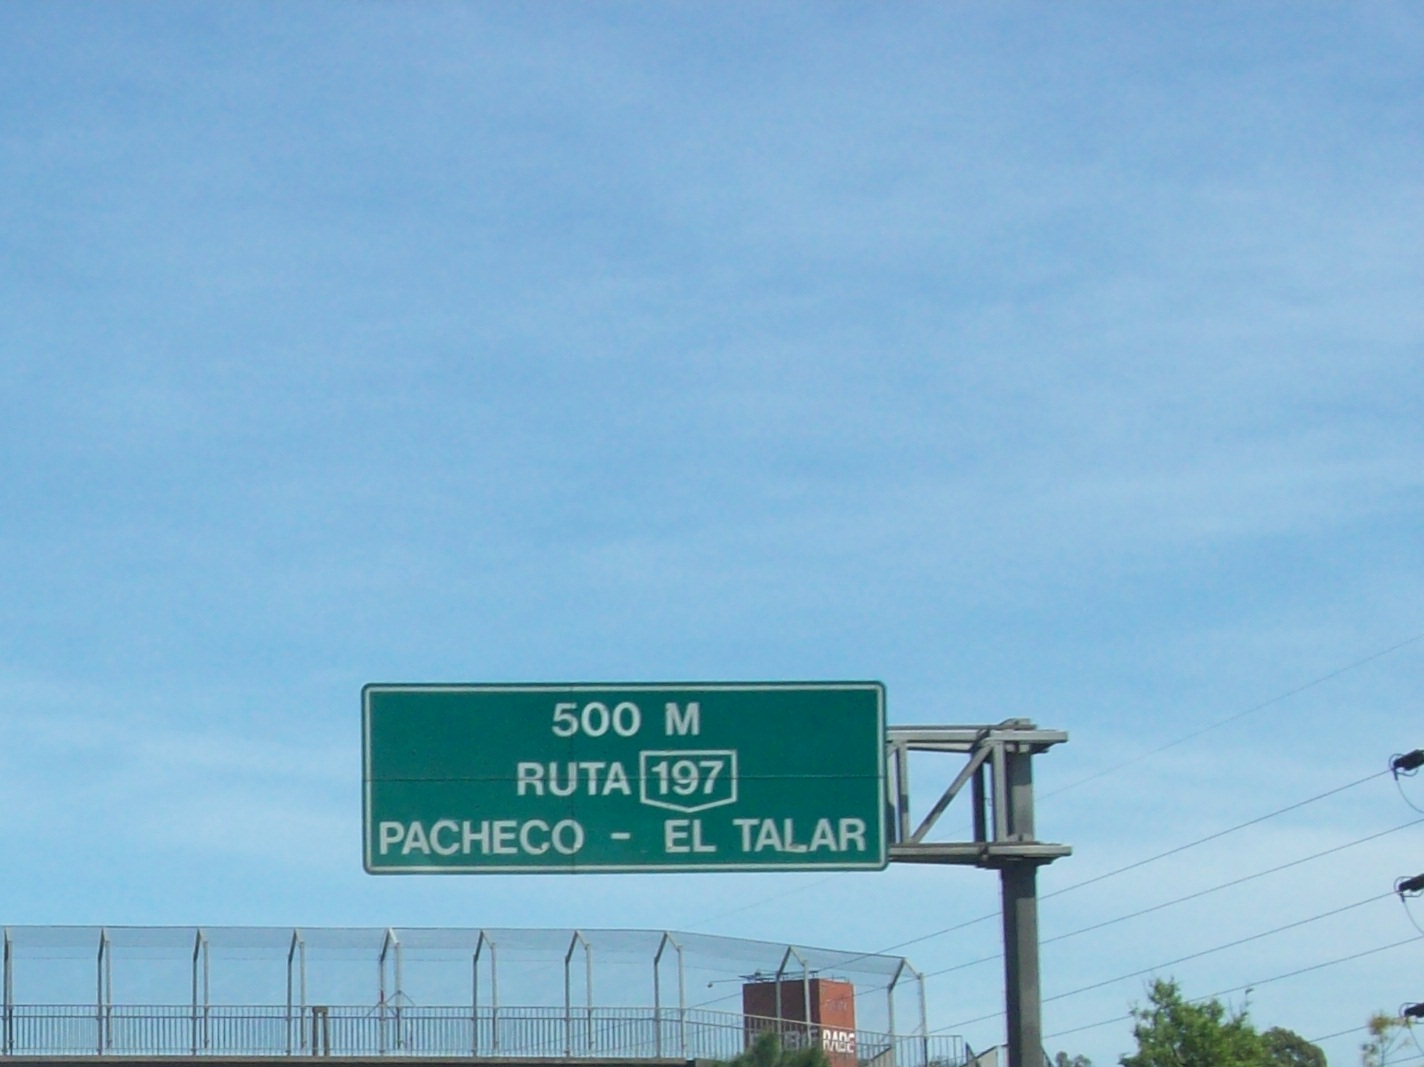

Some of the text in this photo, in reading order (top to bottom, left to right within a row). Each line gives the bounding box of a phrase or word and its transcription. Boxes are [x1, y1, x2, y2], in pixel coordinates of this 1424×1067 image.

[552, 702, 700, 737] 500 M
[517, 760, 725, 797] RUTA 197
[379, 819, 584, 856] PACHECO
[665, 820, 716, 852] EL
[733, 818, 866, 853] TALAR
